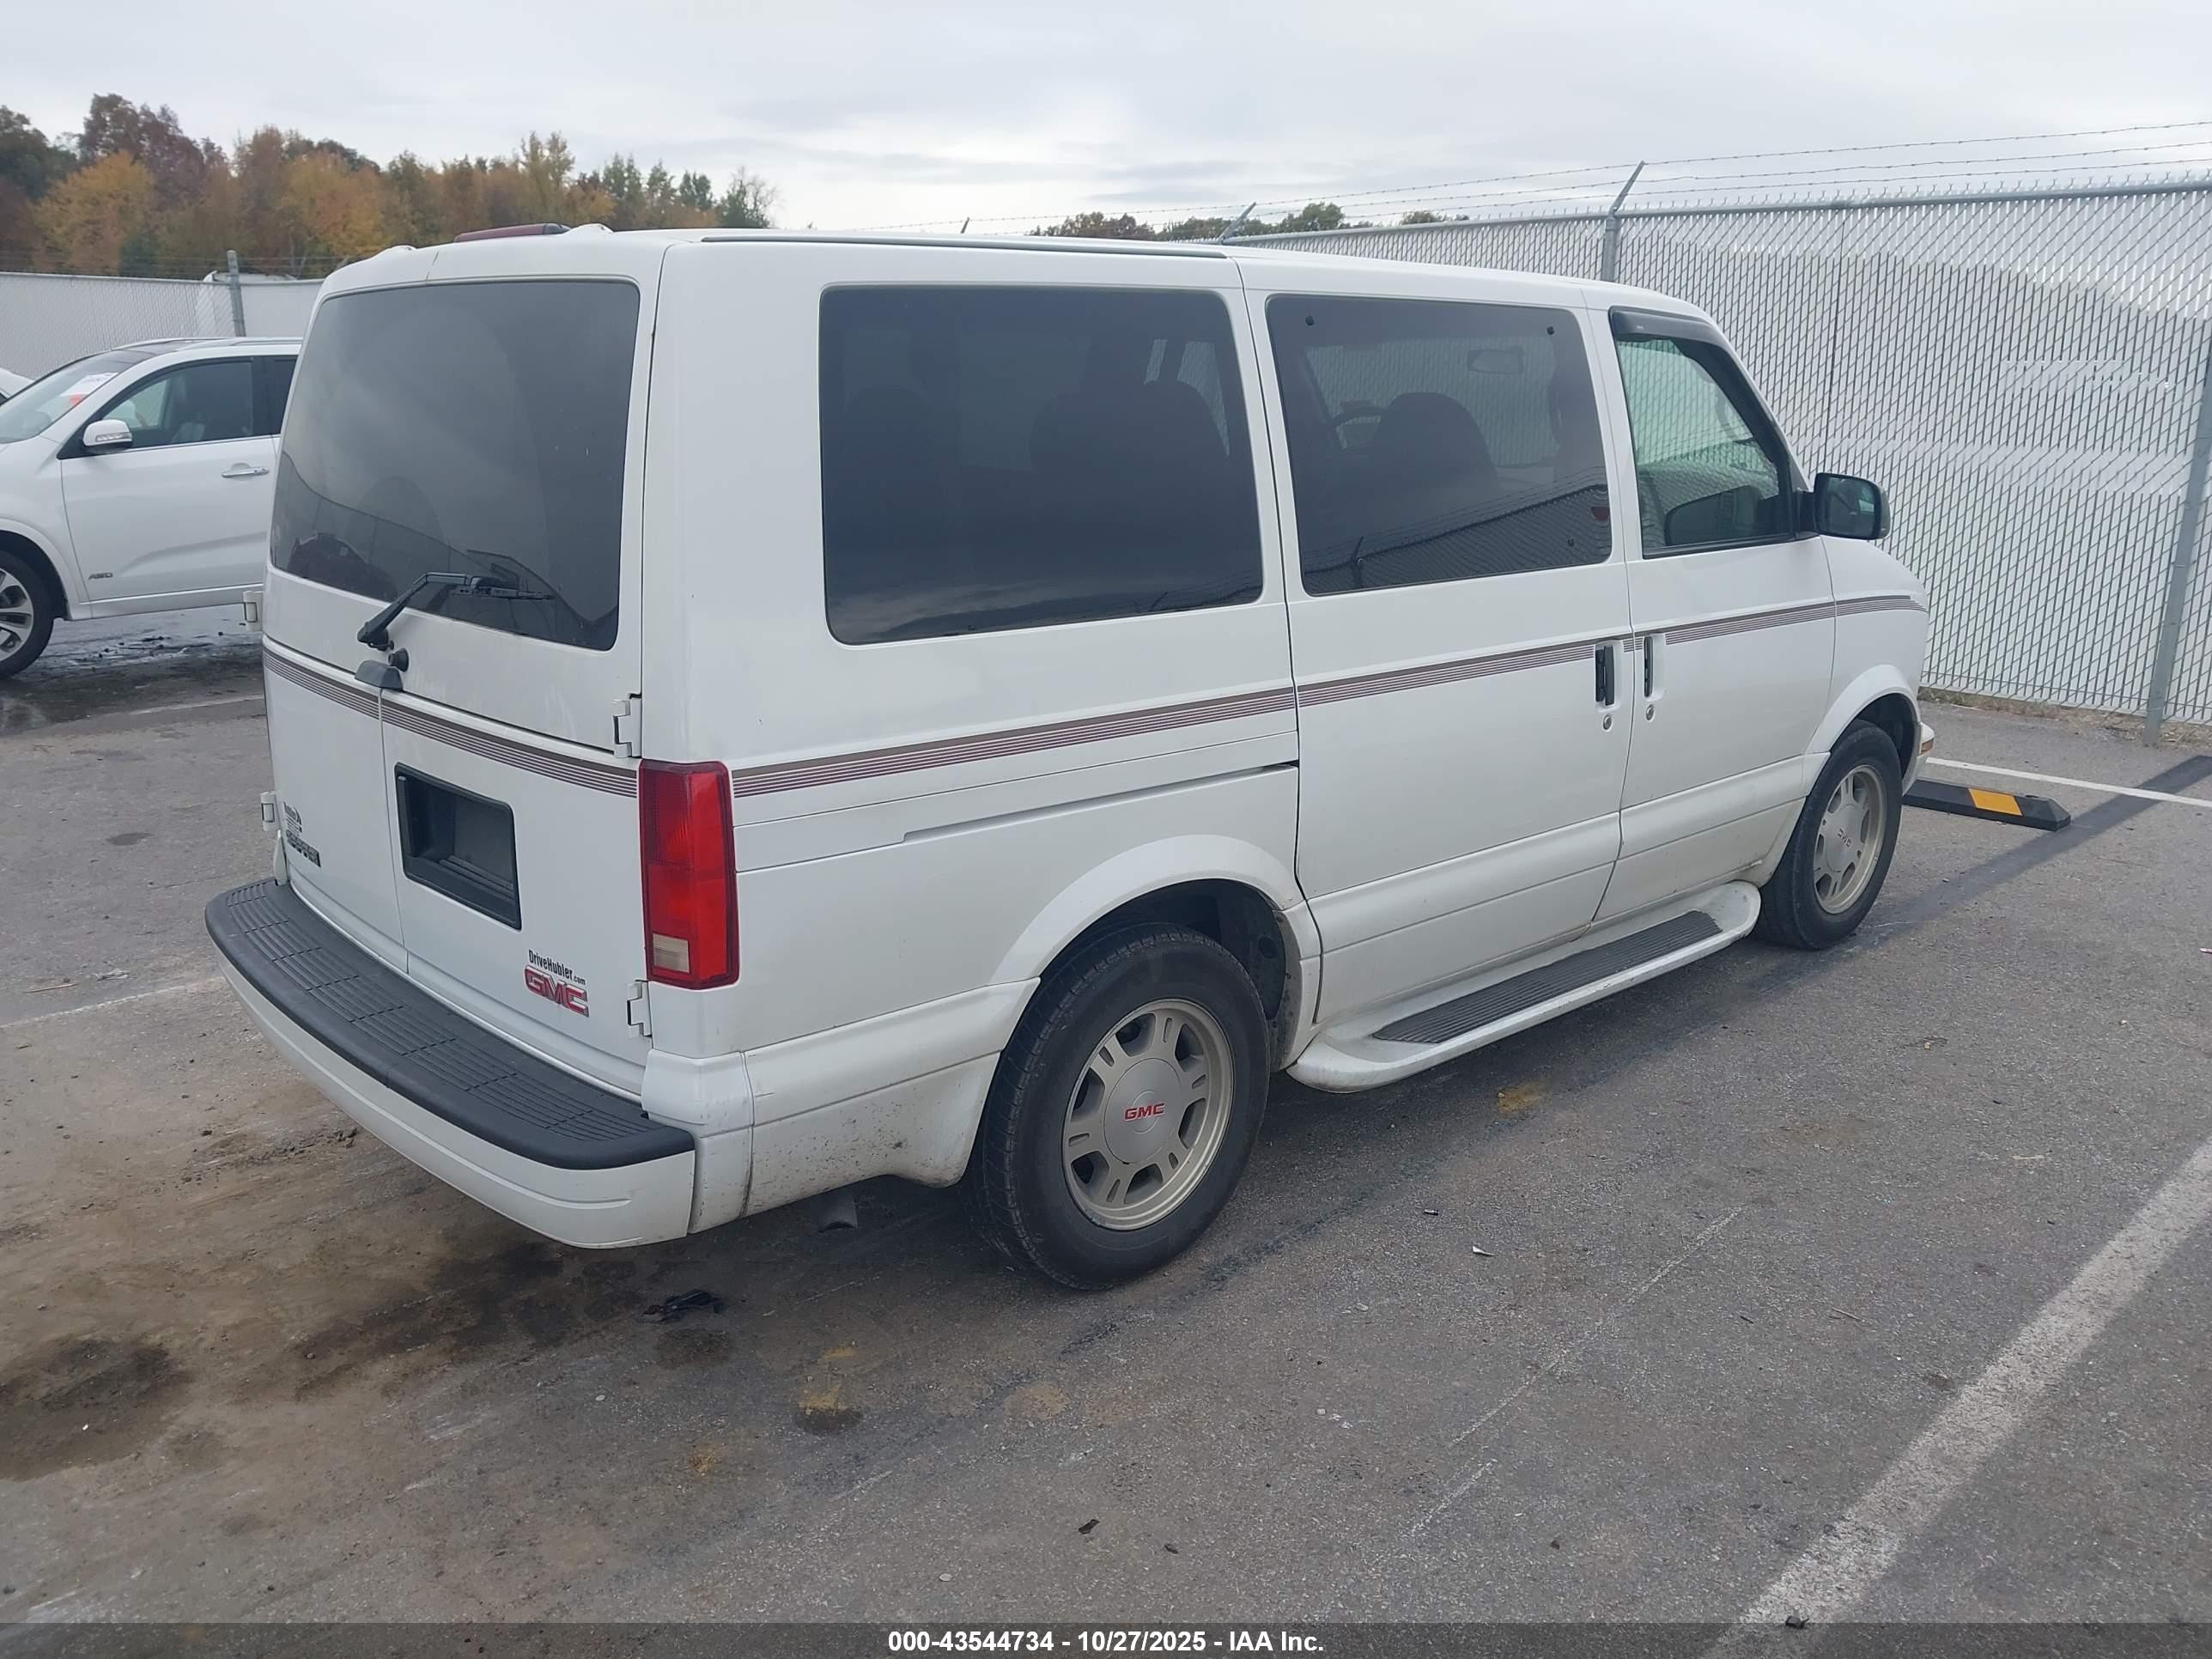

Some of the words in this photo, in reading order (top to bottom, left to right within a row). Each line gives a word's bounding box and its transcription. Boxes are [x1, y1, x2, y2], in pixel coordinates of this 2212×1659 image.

[528, 949, 586, 985] DriveHubler.com
[525, 964, 590, 1018] GMC
[1124, 1102, 1165, 1121] GMC
